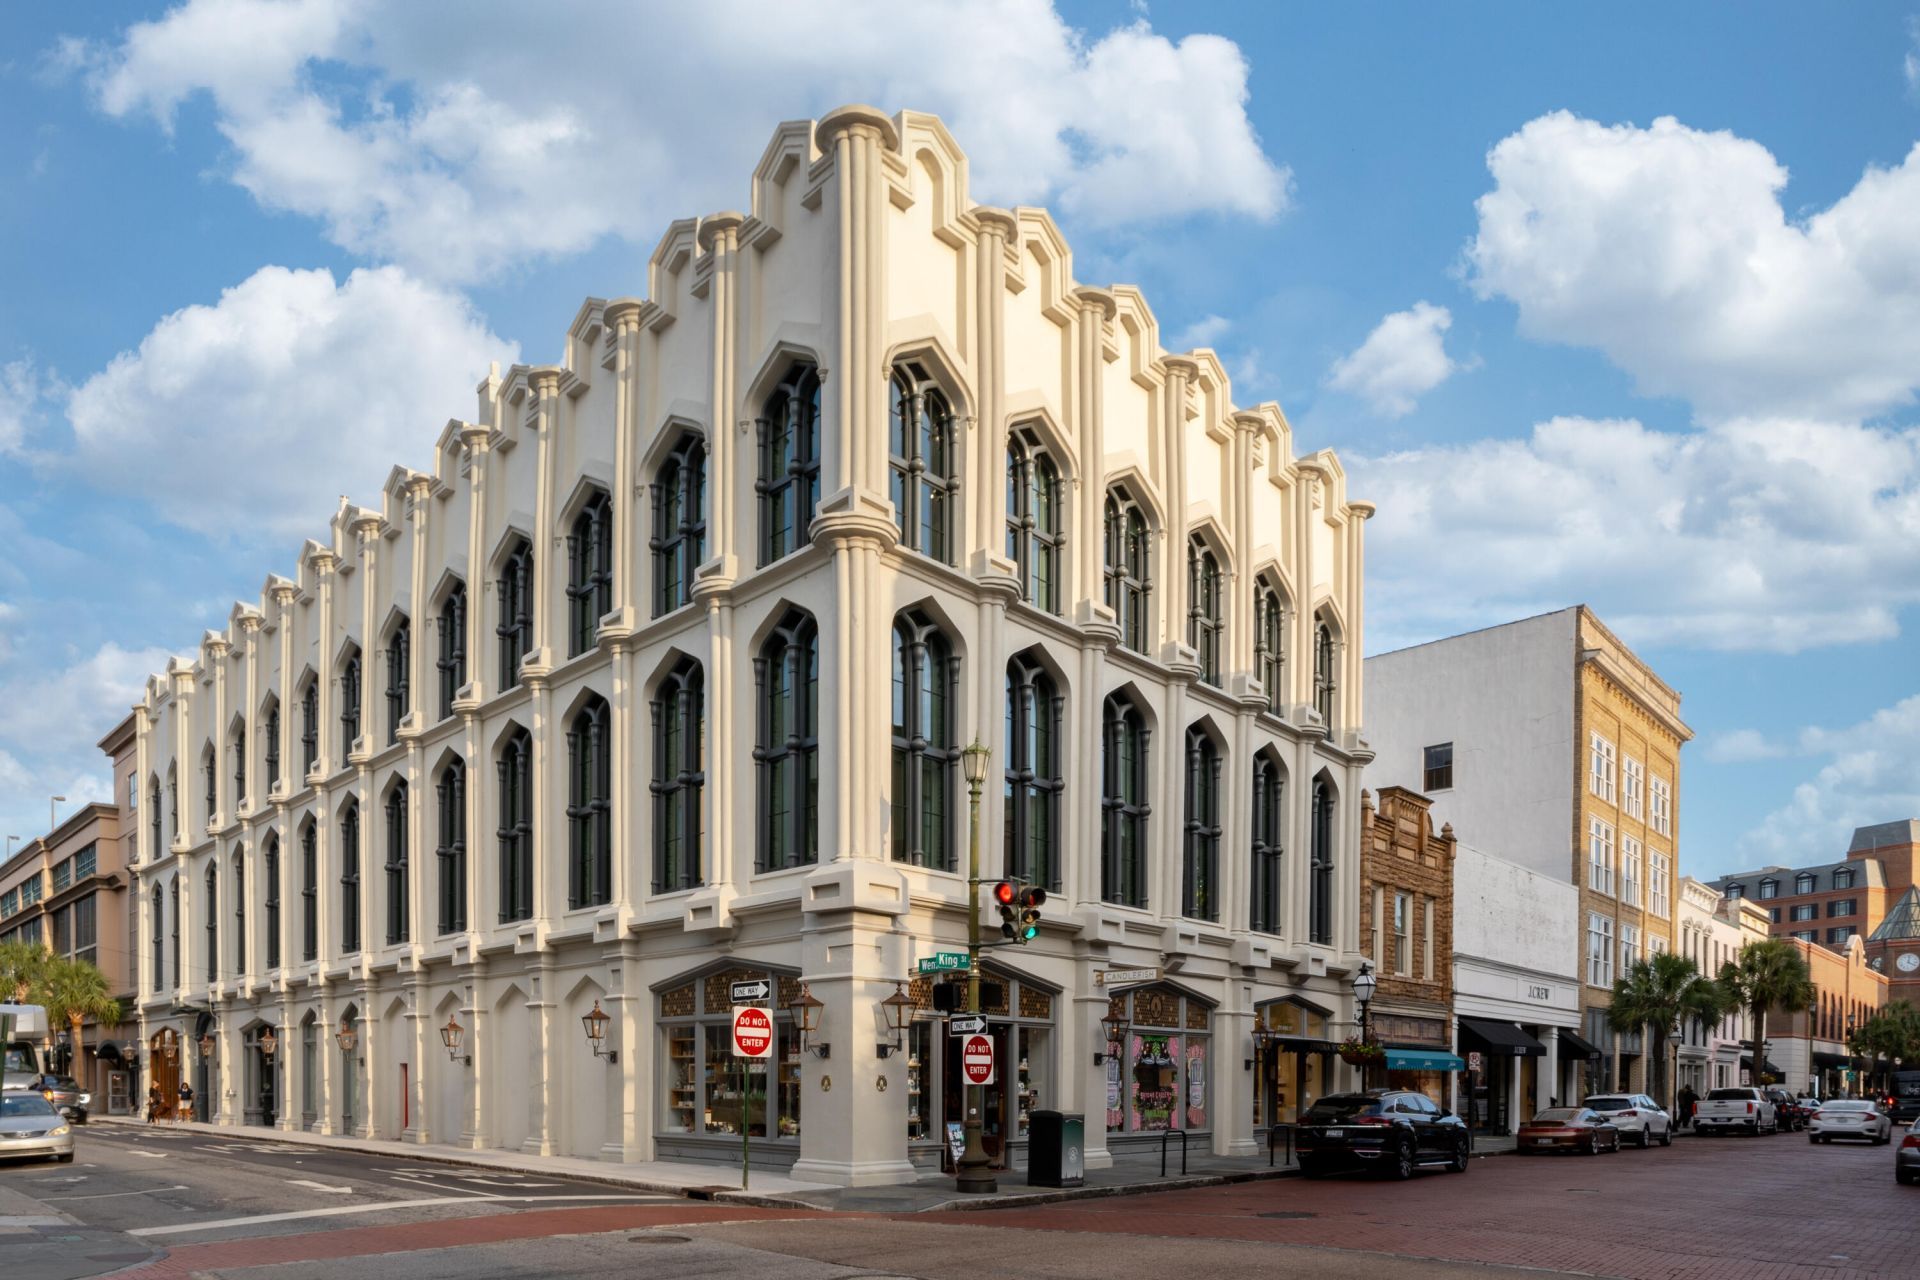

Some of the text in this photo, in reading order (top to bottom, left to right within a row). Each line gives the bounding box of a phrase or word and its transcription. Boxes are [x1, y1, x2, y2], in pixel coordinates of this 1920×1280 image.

[922, 960, 938, 970] Wen
[939, 954, 958, 967] King
[1106, 970, 1154, 980] CANDLEFISH
[735, 986, 758, 996] ONE WAY
[1528, 985, 1550, 1000] J.CREW
[740, 1016, 767, 1026] DO NOT
[965, 1021, 976, 1029] WAY
[742, 1038, 764, 1047] ENTER
[967, 1045, 989, 1053] DO NOT
[970, 1066, 987, 1074] ENTER
